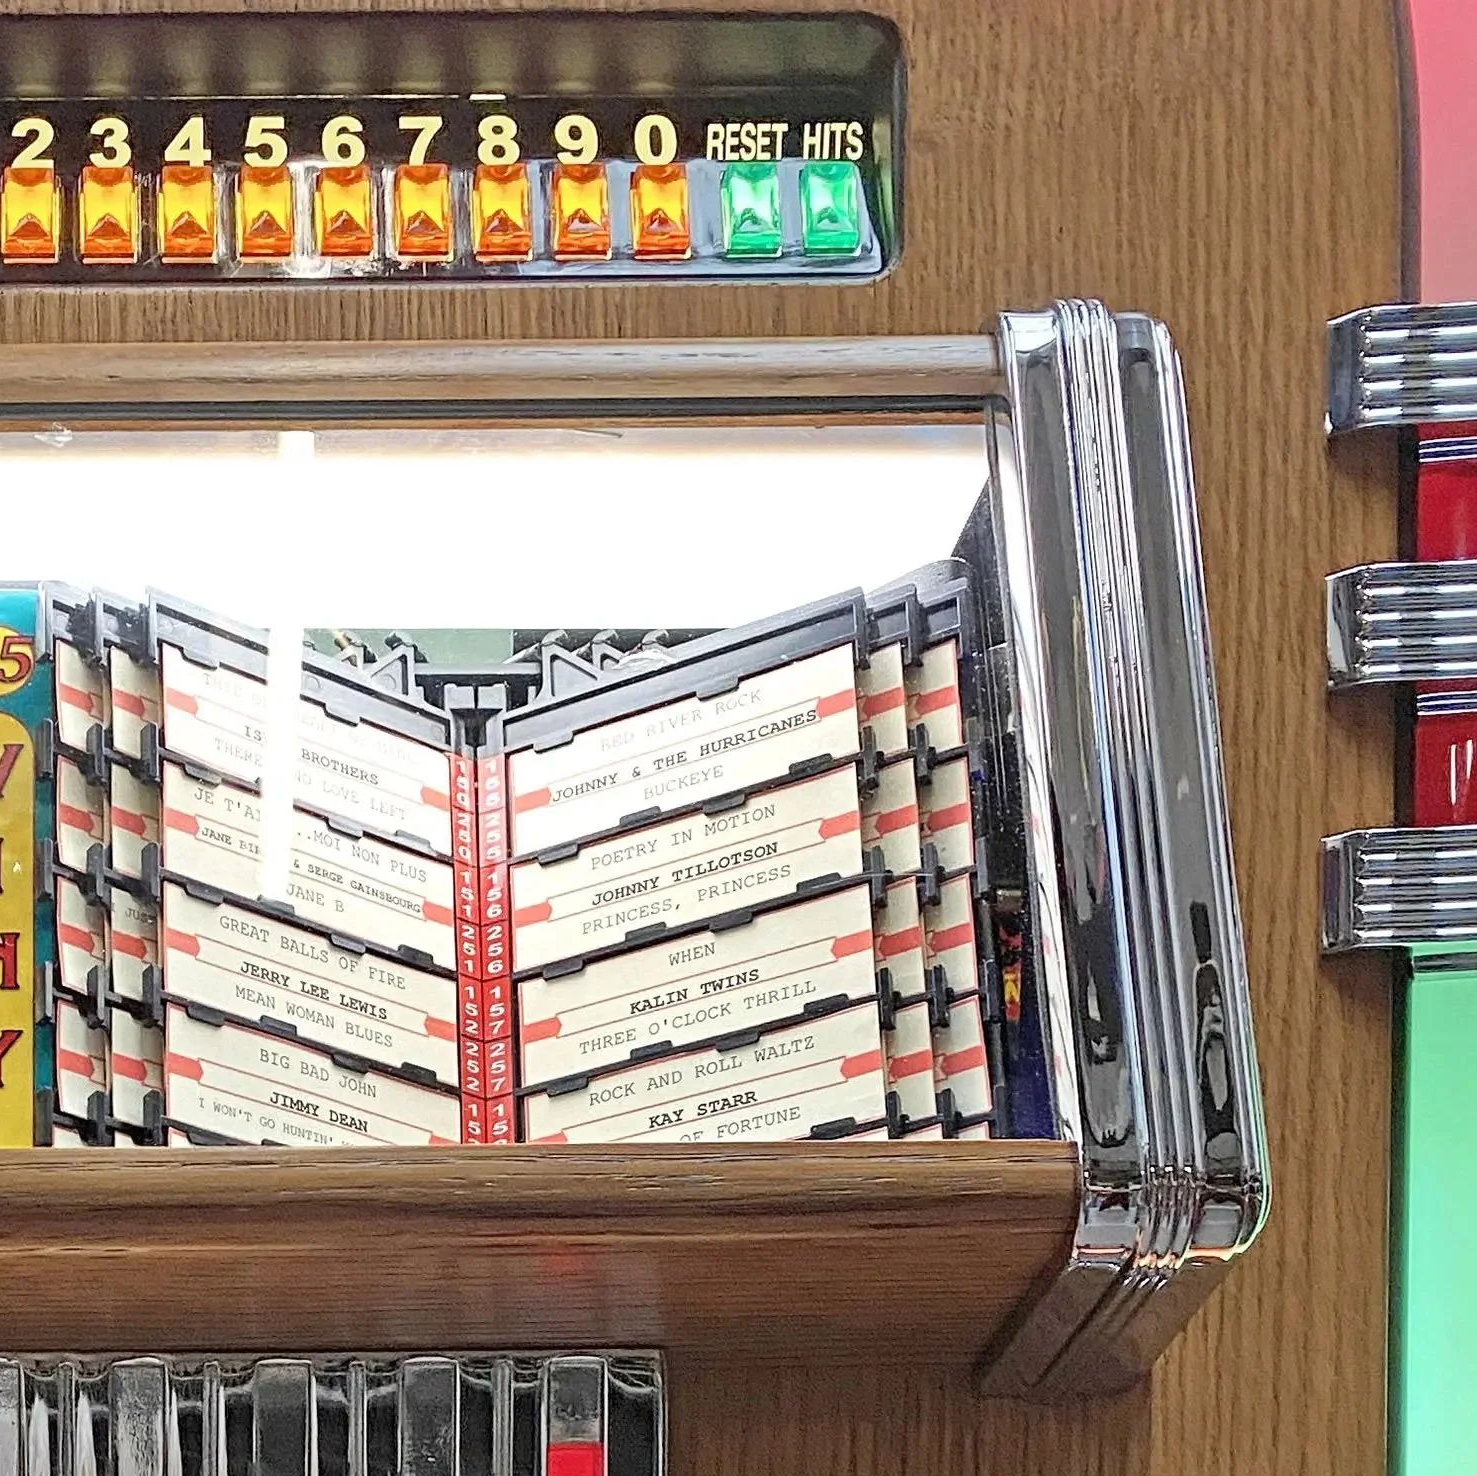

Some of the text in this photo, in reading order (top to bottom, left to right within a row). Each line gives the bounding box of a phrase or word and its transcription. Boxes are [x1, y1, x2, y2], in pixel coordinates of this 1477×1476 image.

[11, 118, 54, 167] 2
[90, 118, 131, 166] 3
[164, 117, 211, 167] 4
[244, 118, 288, 166] 5
[323, 117, 365, 166] 6
[399, 117, 443, 164] 7
[478, 116, 520, 165] 8
[556, 115, 599, 164] 9
[635, 115, 677, 163] 0
[706, 121, 787, 161] RESET
[803, 120, 863, 161] HITS
[302, 748, 378, 784] BROTHERS
[552, 710, 817, 802] JOHNNY & THE HURRICANES
[194, 788, 214, 801] JE
[643, 765, 724, 800] BUCKEYE
[201, 826, 233, 845] JANE
[591, 803, 775, 870] POETRY IN MOTION
[351, 844, 427, 882] NON PLUS
[592, 841, 778, 906] JOHNNY TILLOTSON
[286, 883, 344, 912] JANE B
[307, 862, 343, 884] SERGE
[350, 879, 421, 914] GAINSBOURG
[582, 865, 792, 936] PRINCESS, PRINCESS
[219, 915, 406, 990] GREAT BALLS OF FIRE
[668, 942, 716, 966] WHEN
[240, 961, 387, 1019] JERRY LEE LEWIS
[629, 969, 760, 1015] KALIN TWINS
[235, 986, 393, 1047] MEAN WOMAN BLUES
[579, 981, 817, 1055] THREE O'CLOCK THRILL
[260, 1048, 377, 1098] BIG BAD JOHN
[589, 1036, 815, 1106] ROCK AND ROLL WALTZ
[198, 1097, 205, 1109] I
[213, 1100, 252, 1127] WON'T
[260, 1114, 276, 1129] GO
[282, 1121, 335, 1145] HUNTIN'
[270, 1092, 367, 1133] JIMMY DEAN
[648, 1091, 757, 1128] KAY STARR
[716, 1106, 801, 1139] FORTUNE
